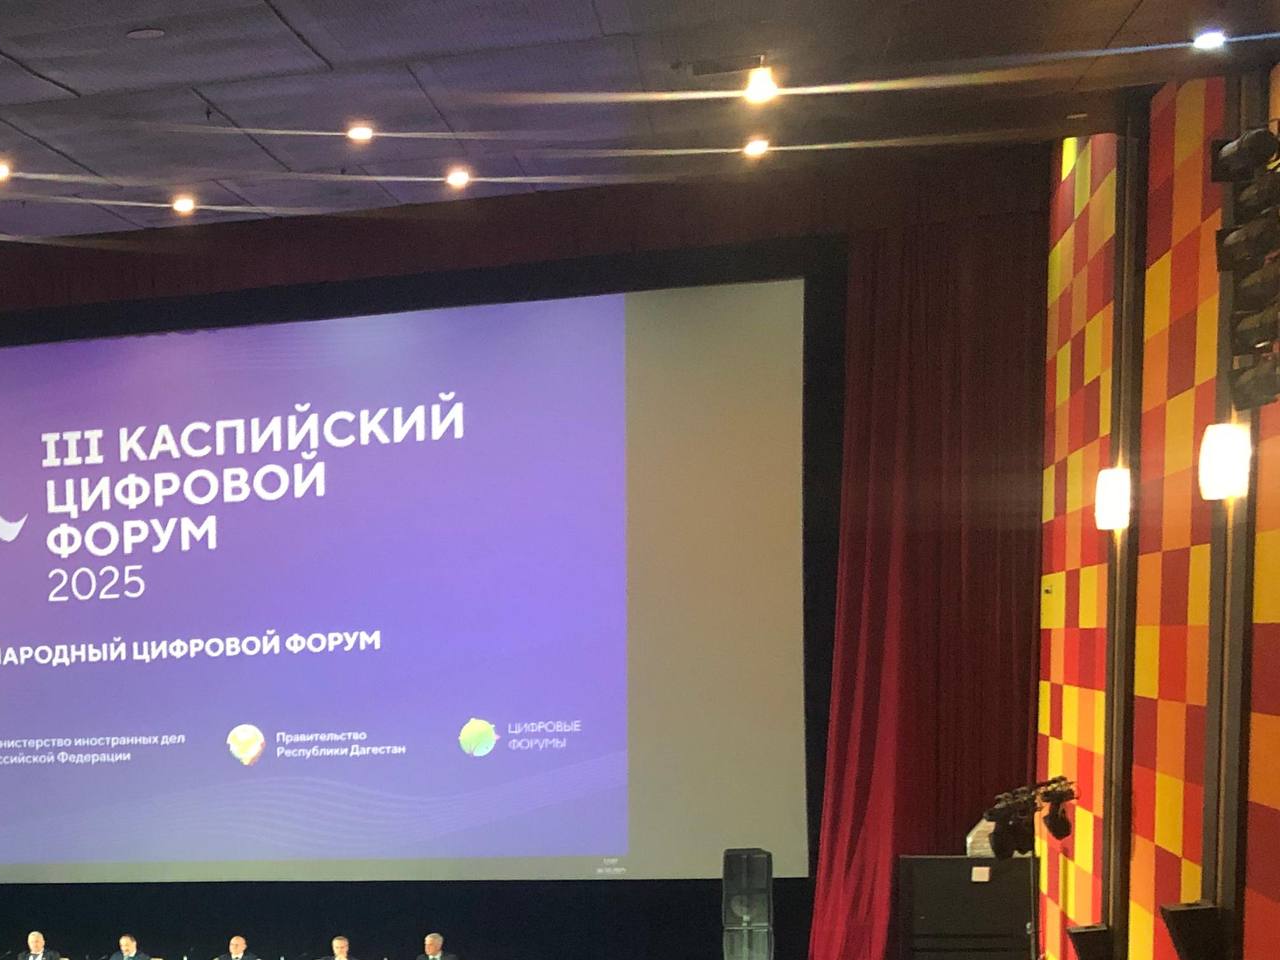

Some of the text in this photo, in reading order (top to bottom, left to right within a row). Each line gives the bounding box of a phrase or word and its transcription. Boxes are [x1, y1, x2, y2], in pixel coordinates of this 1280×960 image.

[119, 391, 464, 463] КАСПИЙСКИЙ
[46, 450, 326, 519] ЦИФРОВОЙ
[46, 515, 218, 558] ФОРУМ
[48, 565, 145, 602] 2025
[132, 629, 281, 663] ЦИФРОВОЙ
[285, 630, 382, 655] ФОРУМ
[507, 720, 583, 735] ЦИФРОВЫЕ
[74, 734, 159, 748] иностранных
[160, 733, 187, 746] дел
[276, 731, 368, 745] Правительство
[507, 738, 568, 752] ФОРУМЫ
[56, 750, 132, 765] Федерации
[276, 744, 407, 760] Республики Дагестан
